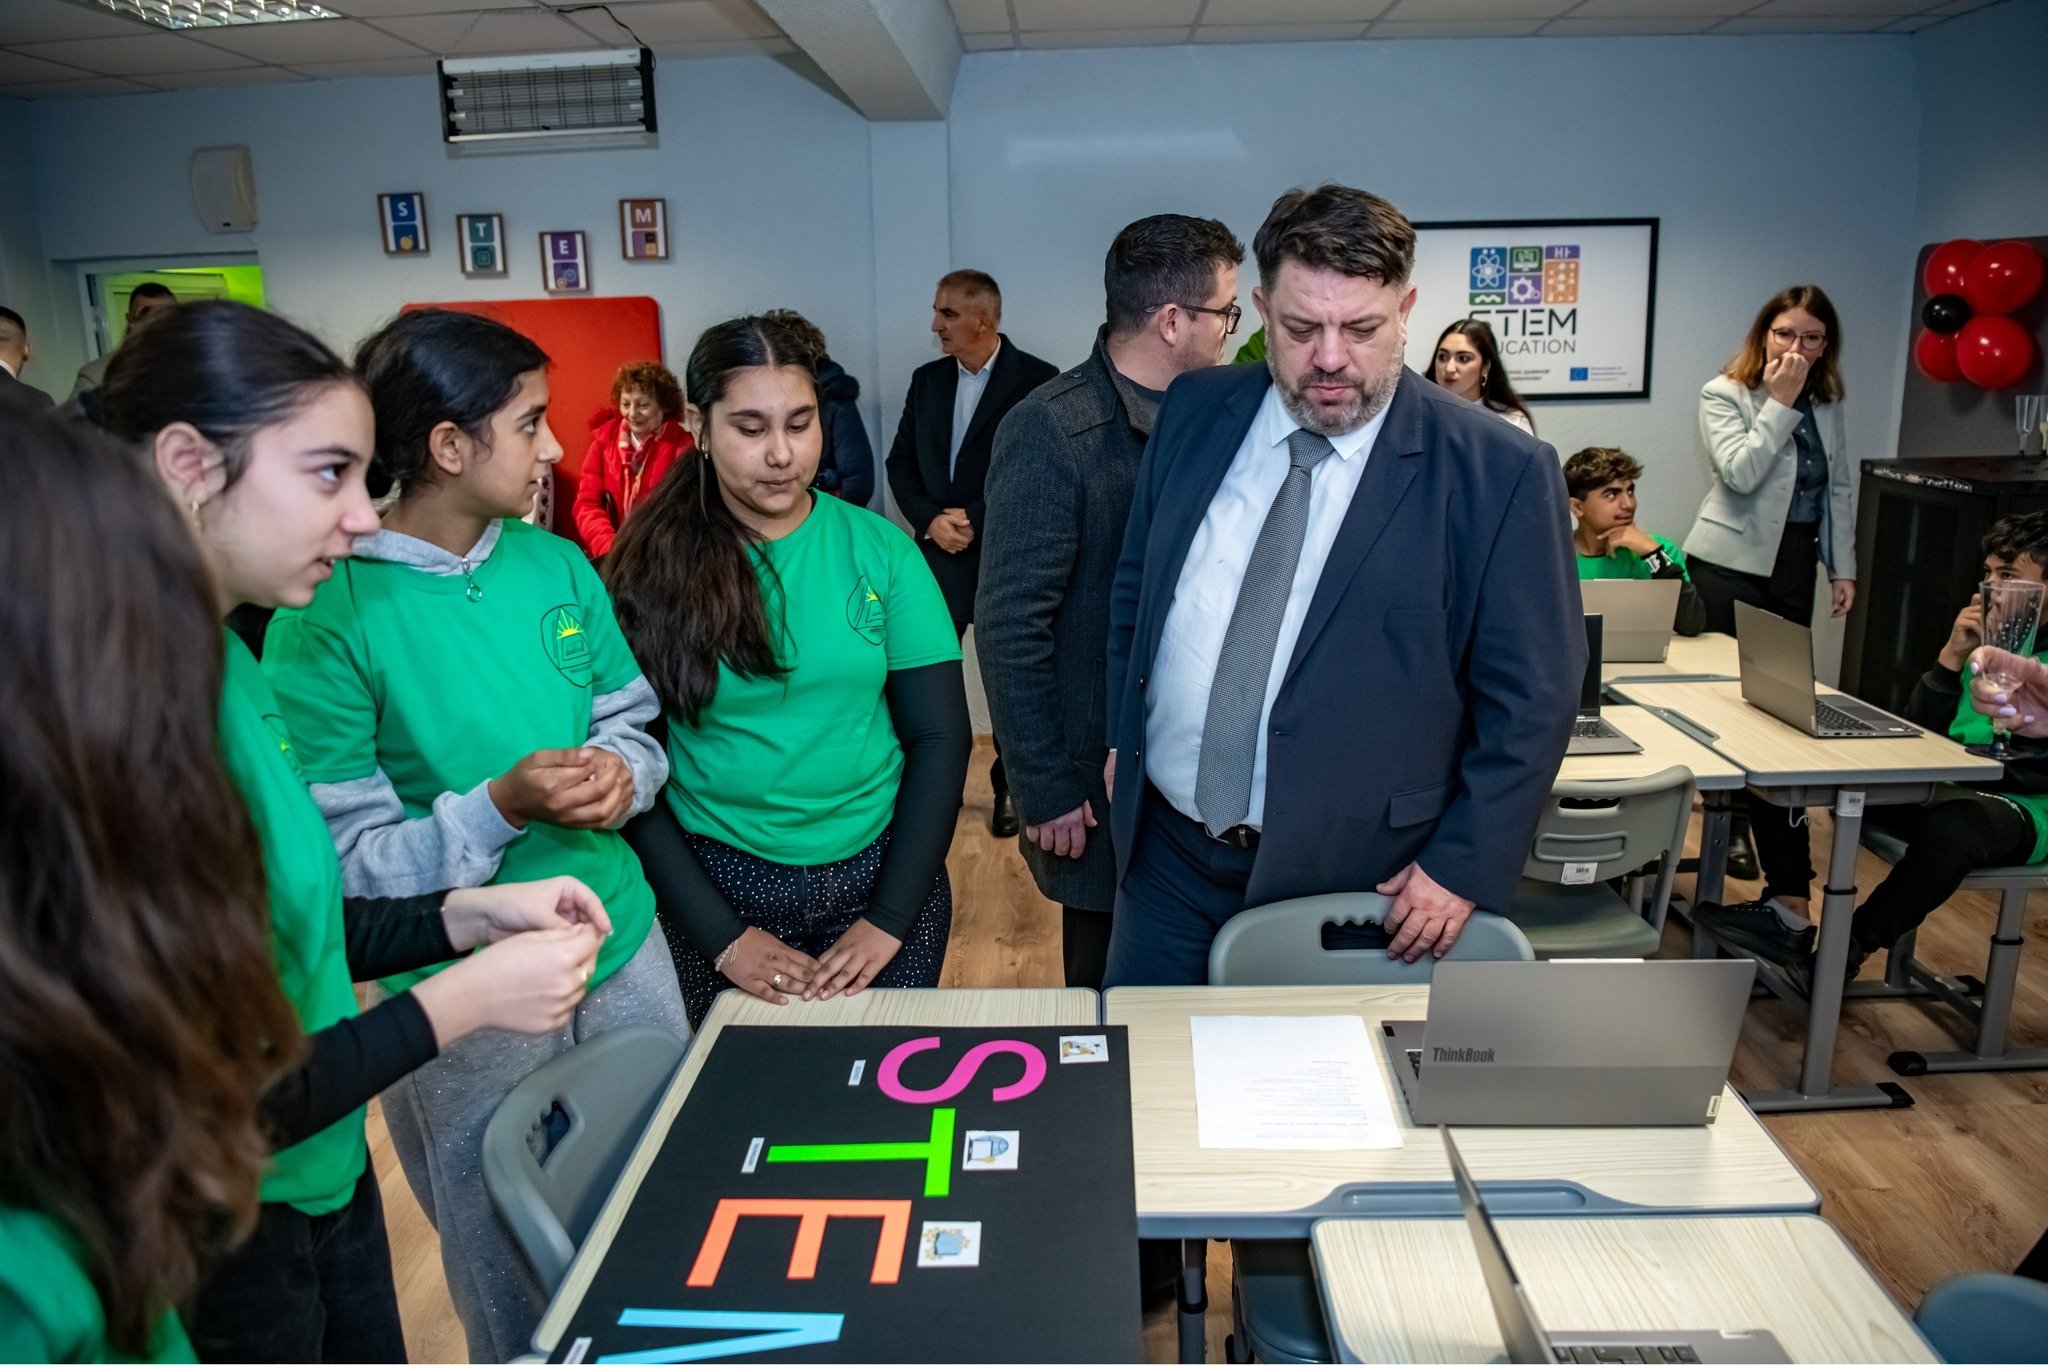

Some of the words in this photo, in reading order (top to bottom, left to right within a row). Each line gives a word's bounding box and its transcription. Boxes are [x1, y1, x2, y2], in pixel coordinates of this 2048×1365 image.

[398, 201, 408, 217] S
[475, 222, 487, 237] T
[559, 240, 569, 254] E
[635, 208, 652, 223] M
[1498, 340, 1576, 354] CATION
[1433, 1047, 1496, 1063] ThinkBook
